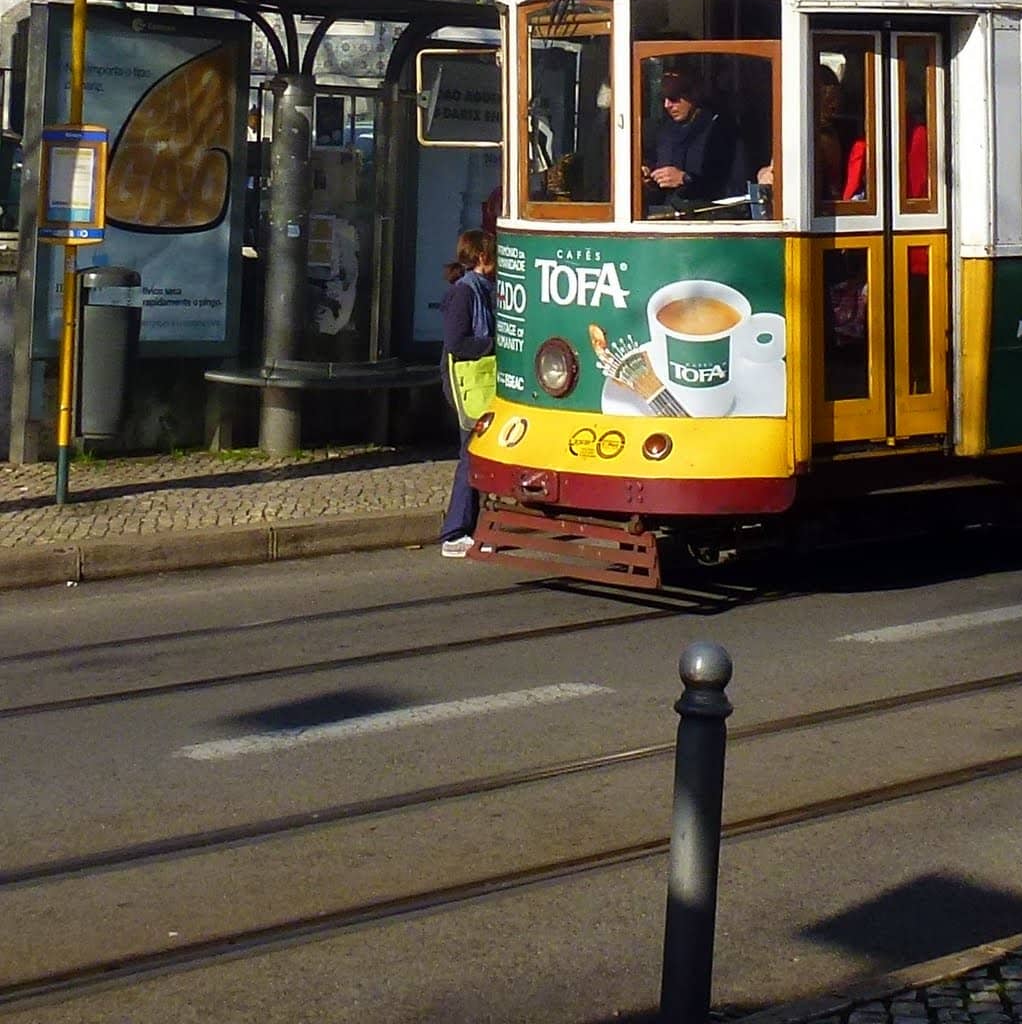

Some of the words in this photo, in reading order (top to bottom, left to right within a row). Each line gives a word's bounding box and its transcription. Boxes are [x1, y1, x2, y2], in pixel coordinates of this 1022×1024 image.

[557, 247, 600, 261] CAFÉS
[534, 259, 630, 309] TOFA
[669, 361, 727, 383] TOFA
